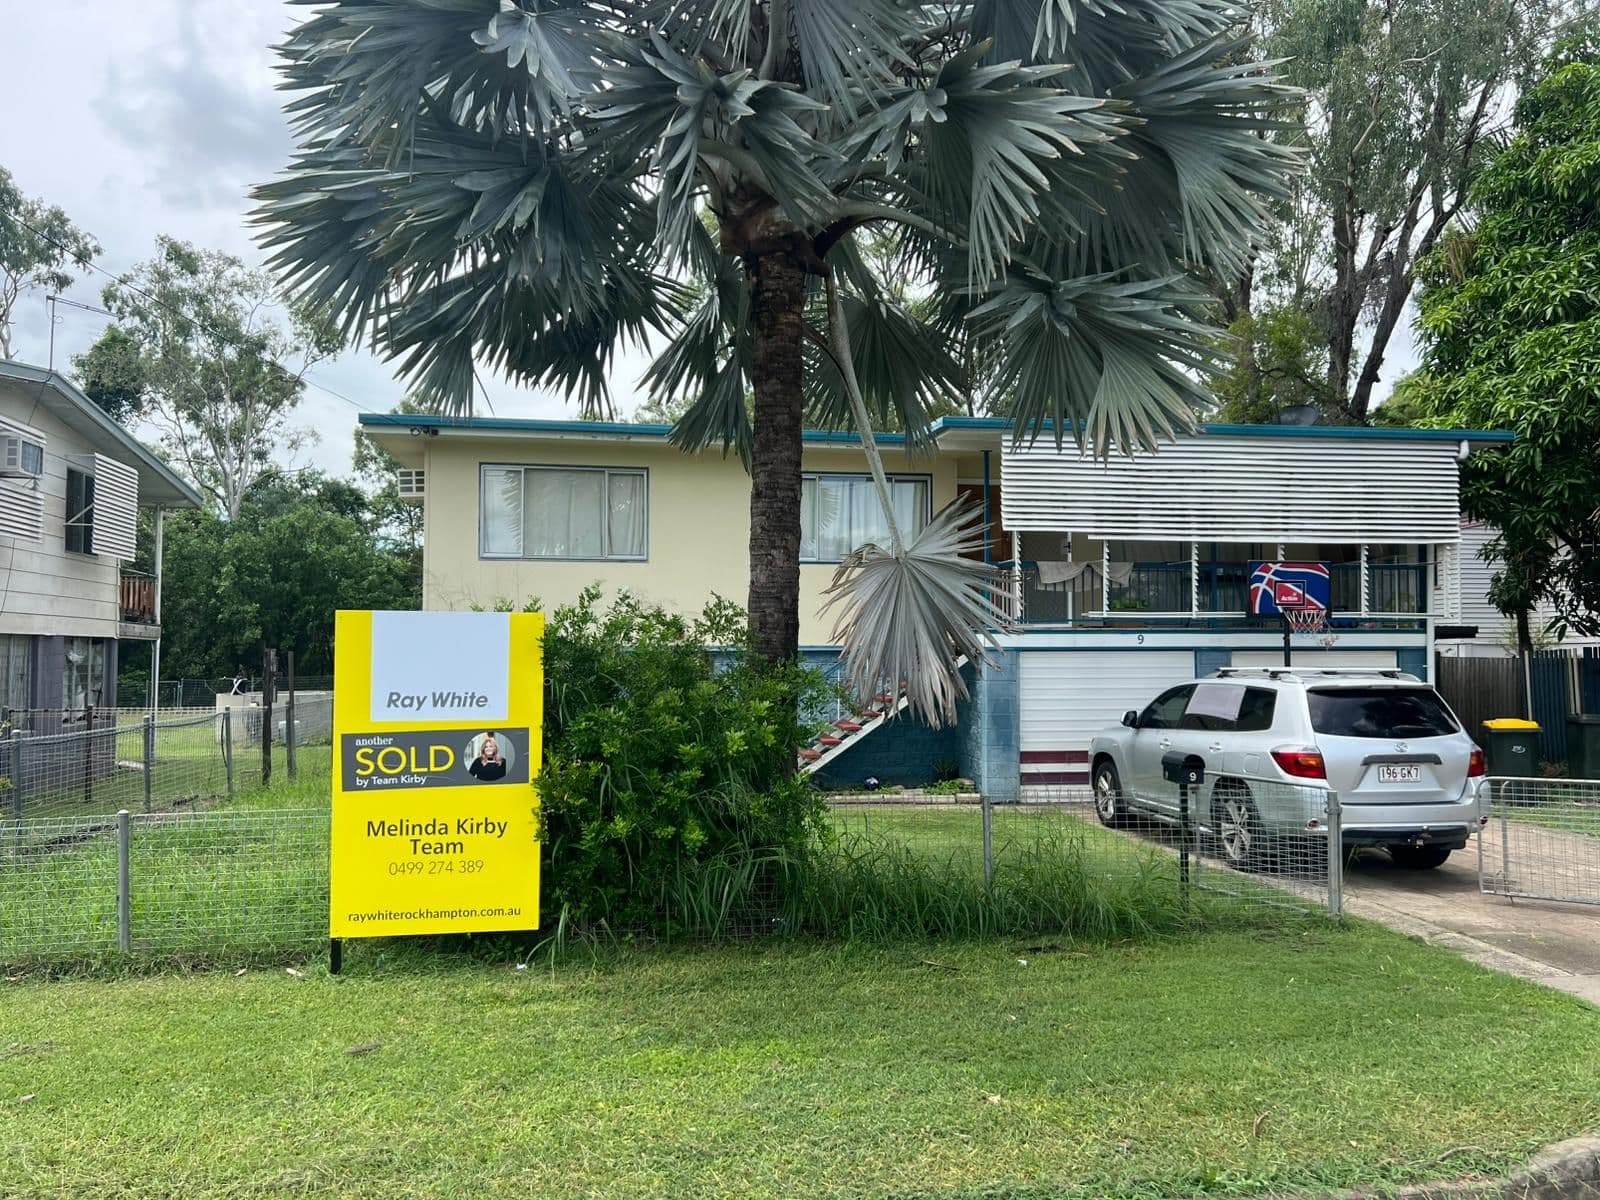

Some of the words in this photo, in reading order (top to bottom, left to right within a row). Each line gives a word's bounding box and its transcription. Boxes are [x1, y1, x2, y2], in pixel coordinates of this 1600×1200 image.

[1137, 634, 1144, 644] 9
[386, 691, 428, 711] Ray
[431, 691, 488, 708] White
[355, 735, 393, 746] another
[355, 744, 455, 776] SOLD
[356, 776, 370, 787] by
[371, 775, 398, 786] Team
[400, 774, 427, 785] Kirby
[1189, 771, 1197, 781] 9
[1382, 767, 1398, 778] 196
[1400, 767, 1419, 778] GK7
[366, 818, 449, 837] Melinda
[456, 817, 508, 838] Kirby
[410, 838, 464, 855] Team
[388, 861, 424, 876] 0499
[428, 860, 454, 875] 274
[458, 859, 485, 874] 389
[348, 906, 521, 924] raywhiterockhampton.com.au
